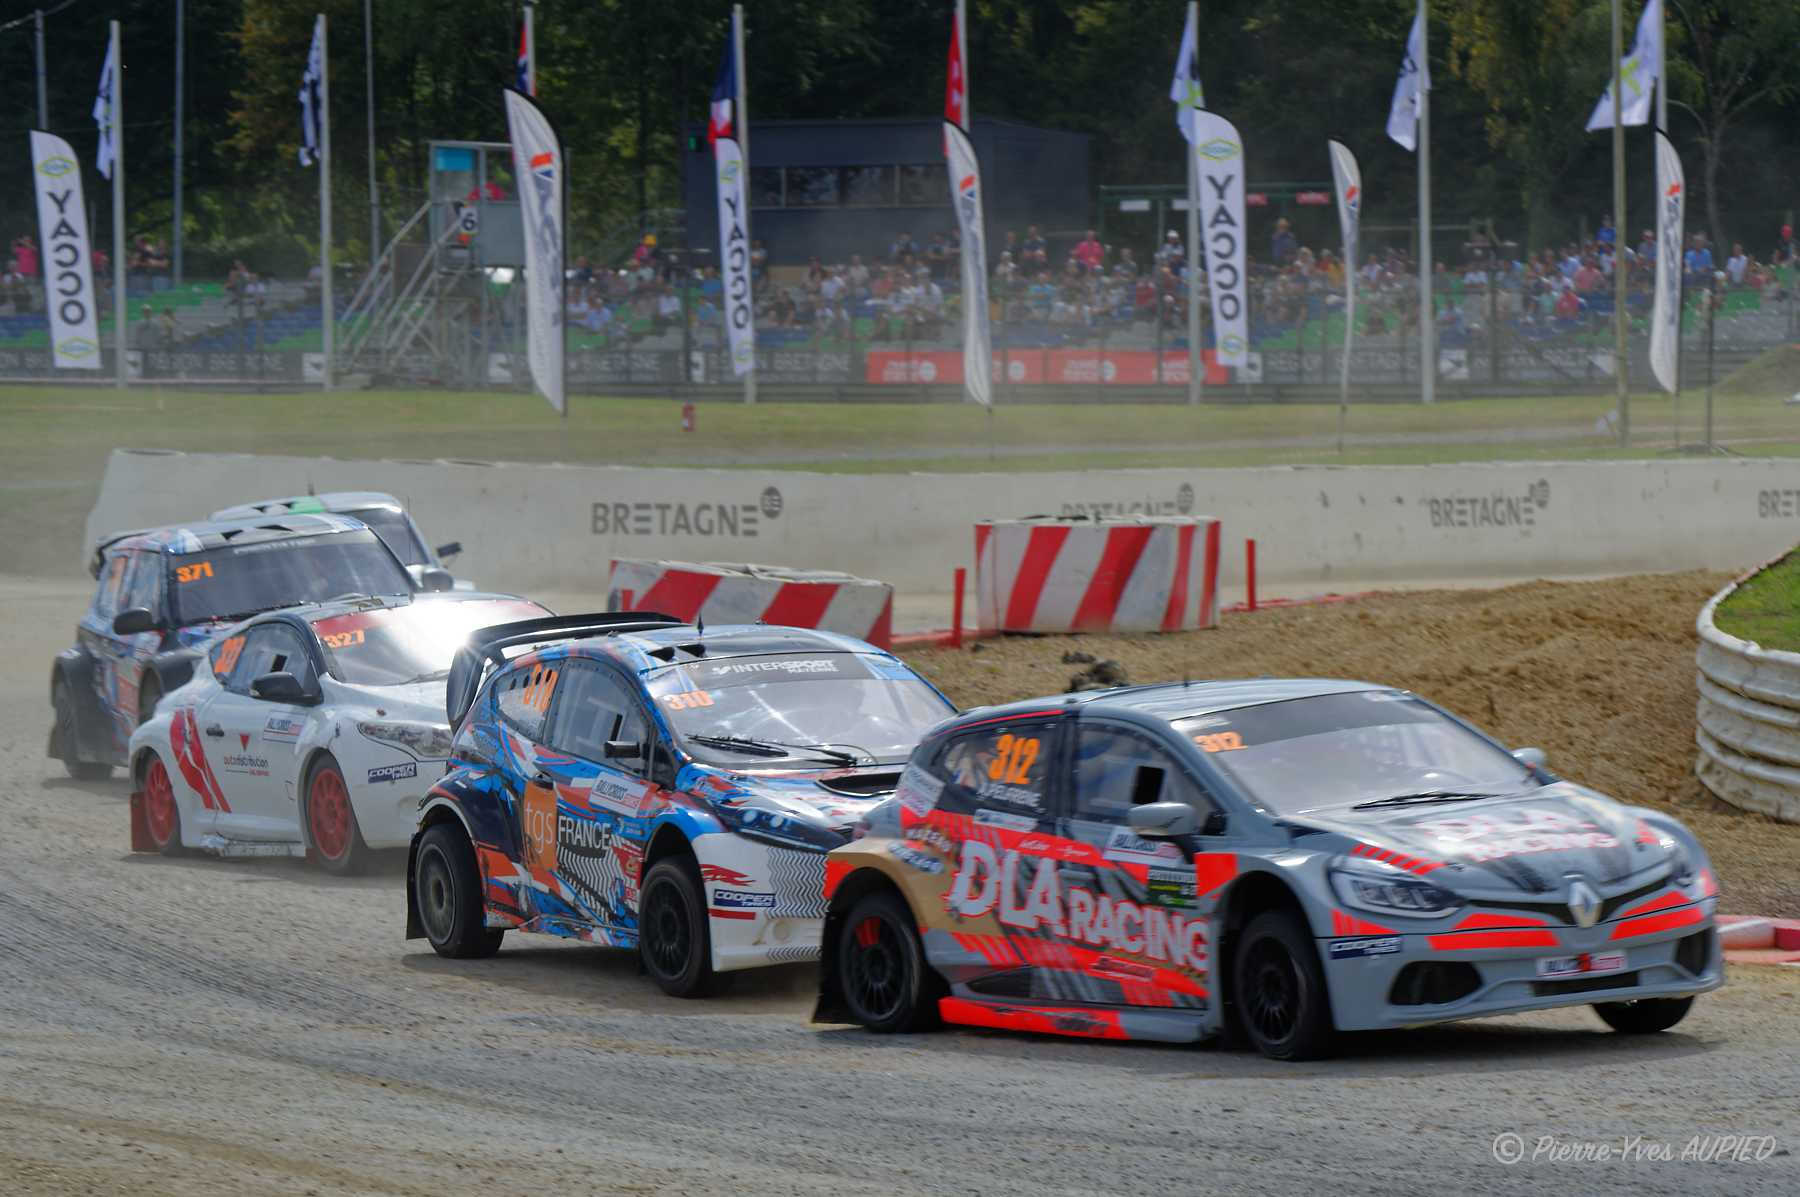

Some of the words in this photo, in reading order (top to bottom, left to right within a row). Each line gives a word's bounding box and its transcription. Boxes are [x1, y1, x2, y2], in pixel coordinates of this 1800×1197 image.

[1430, 497, 1536, 528] BRETAGNE
[1758, 489, 1800, 519] BRE
[591, 502, 759, 537] BRETAGNE
[176, 561, 215, 584] 371
[323, 629, 366, 649] 327
[732, 659, 836, 673] INTERSPORT
[669, 690, 715, 711] 310
[368, 764, 416, 778] COOPER
[988, 734, 1041, 785] 312
[525, 802, 554, 854] tgs
[558, 816, 612, 851] FRANCE
[714, 890, 774, 902] COOPER
[949, 839, 1069, 937] DLA
[1067, 885, 1210, 973] RACING
